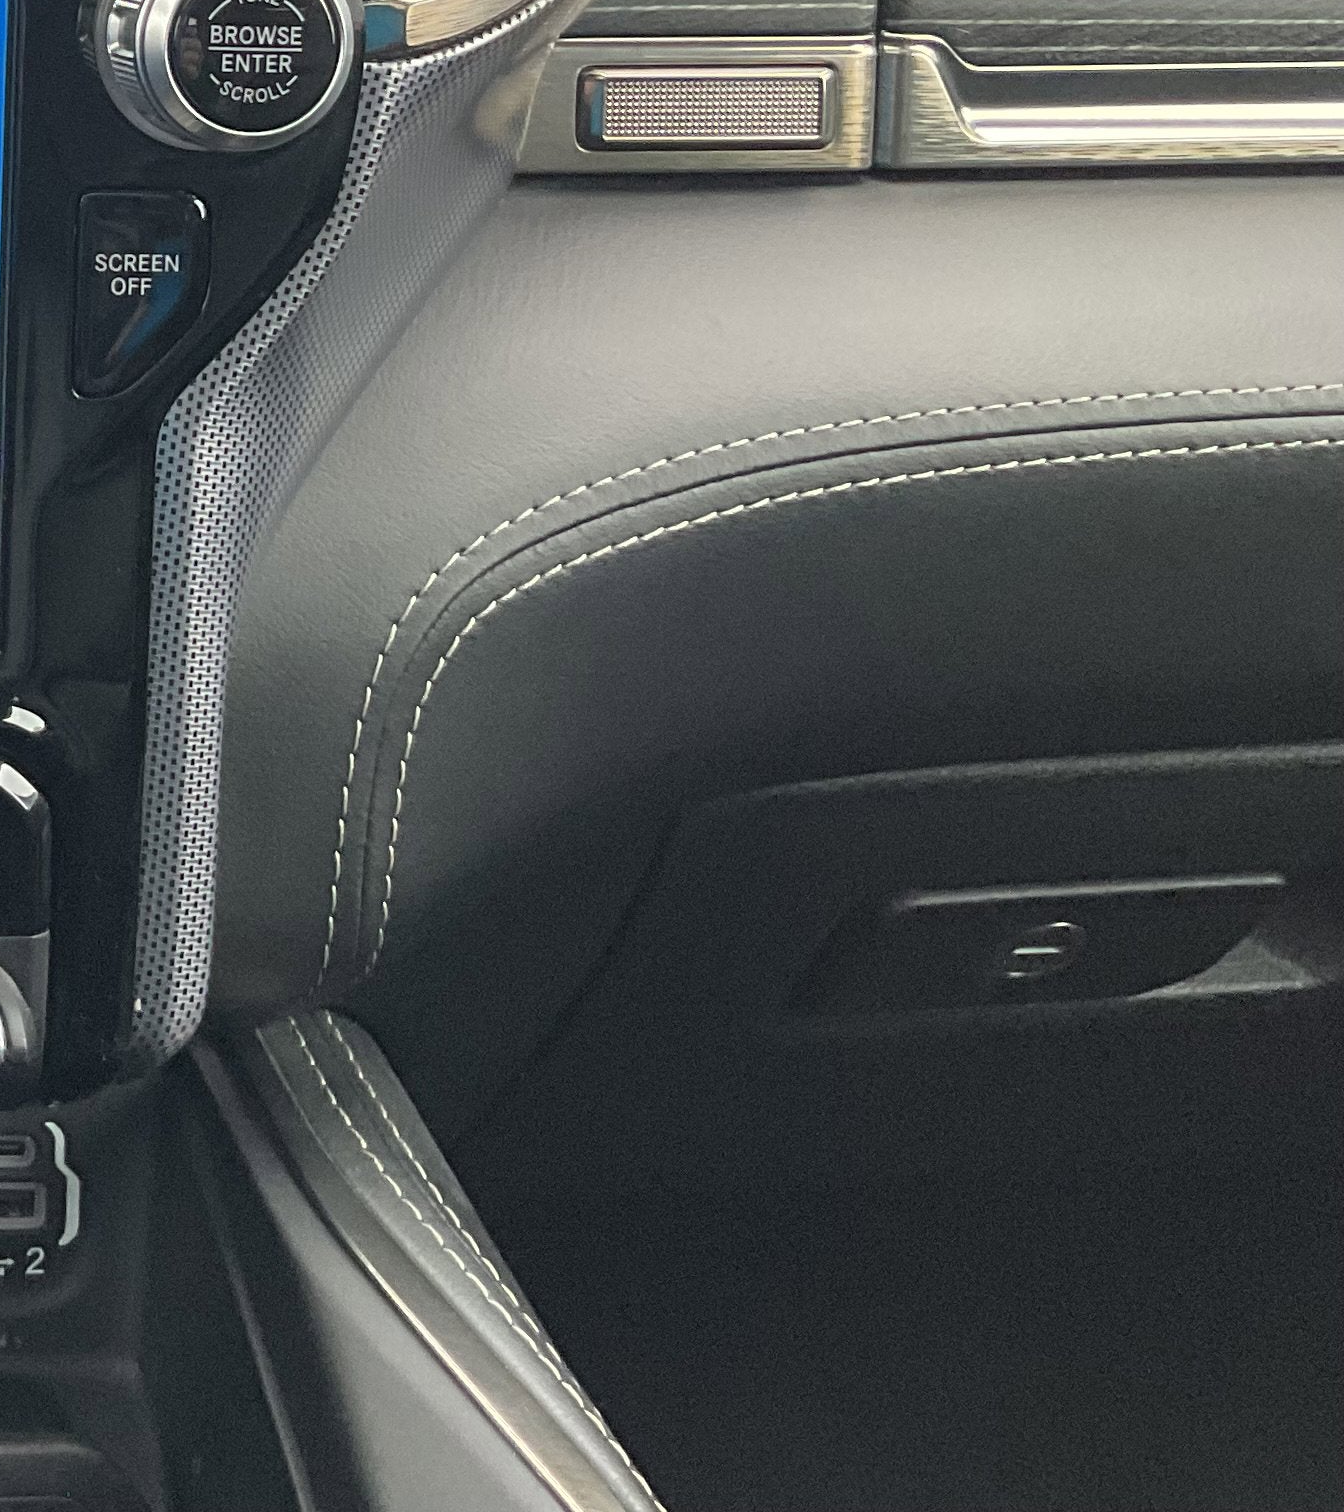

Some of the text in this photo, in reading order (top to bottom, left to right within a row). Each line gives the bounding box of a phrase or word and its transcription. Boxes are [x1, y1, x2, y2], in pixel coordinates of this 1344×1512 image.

[211, 24, 302, 45] BROWSE
[221, 54, 292, 74] ENTER
[219, 81, 290, 104] SCROLL
[94, 254, 180, 272] SCREEN
[111, 278, 151, 296] OFF
[25, 1247, 46, 1275] 2
